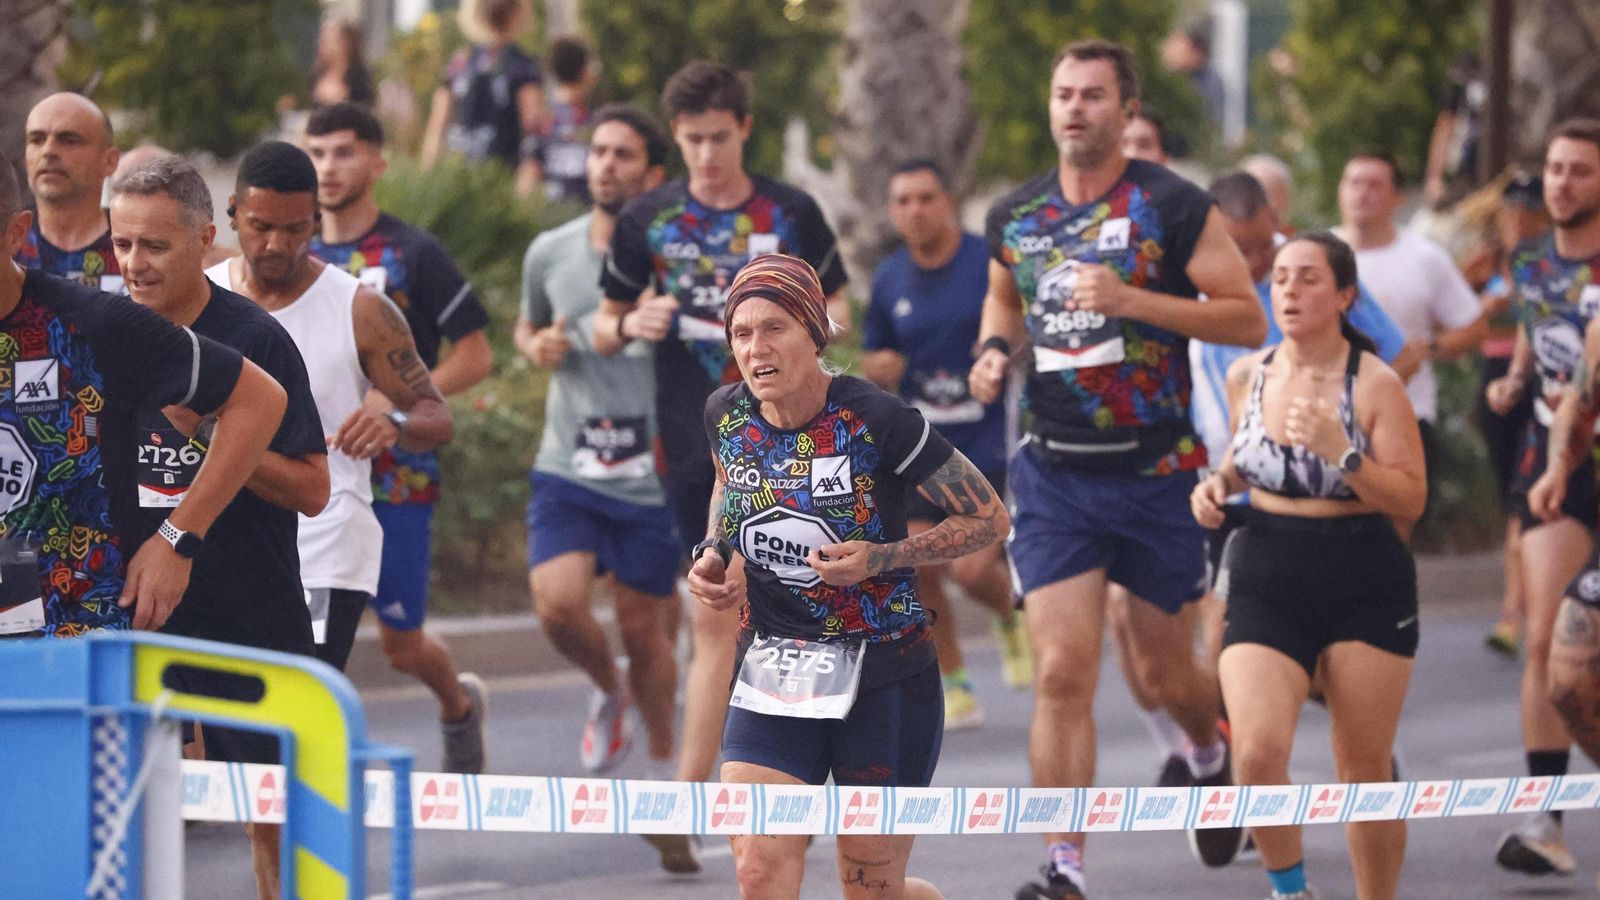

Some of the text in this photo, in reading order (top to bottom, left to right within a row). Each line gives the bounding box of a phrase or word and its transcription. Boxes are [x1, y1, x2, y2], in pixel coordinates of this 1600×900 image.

[15, 381, 51, 399] AXA
[812, 475, 846, 493] AXA
[813, 495, 856, 507] fundación
[762, 647, 836, 674] 2575
